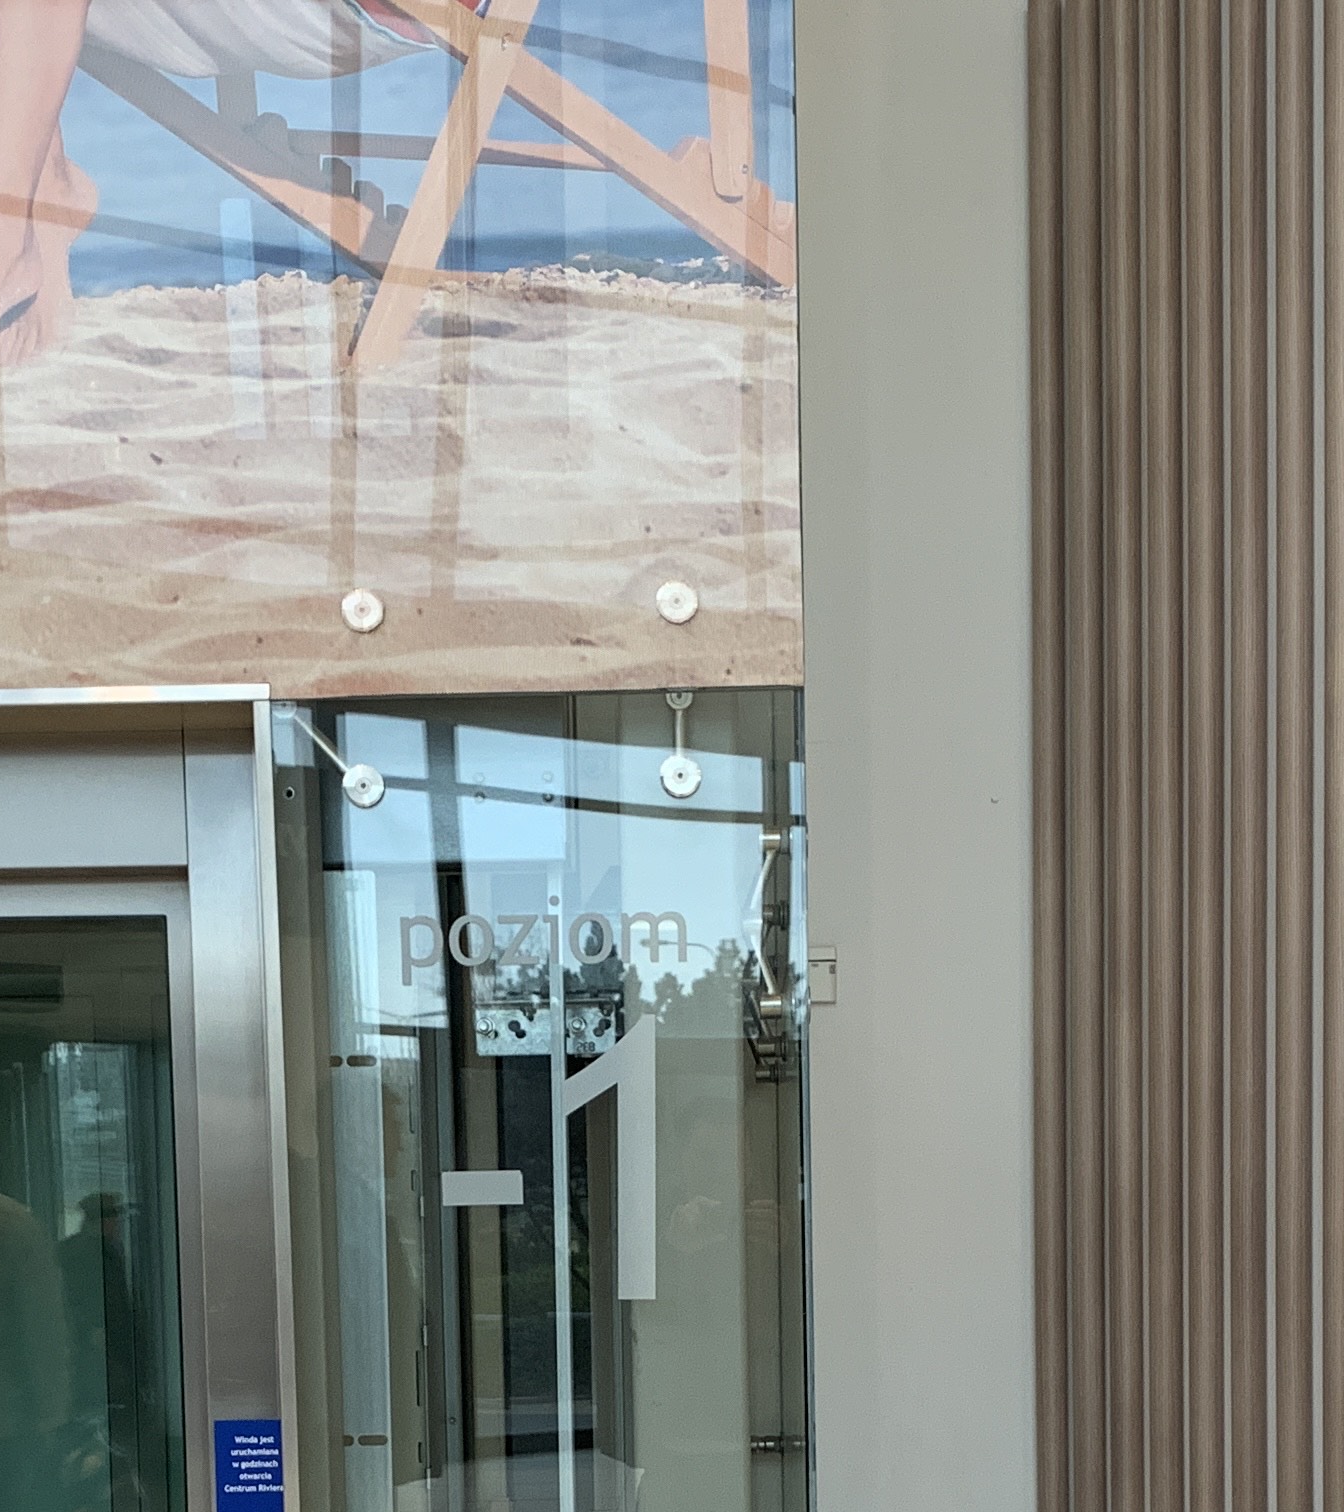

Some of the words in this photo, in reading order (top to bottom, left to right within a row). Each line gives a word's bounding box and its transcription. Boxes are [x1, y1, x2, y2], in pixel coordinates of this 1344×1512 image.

[399, 895, 688, 986] poziom
[234, 1436, 258, 1444] Winda
[259, 1435, 275, 1445] jest
[230, 1448, 279, 1456] uruchamiana
[240, 1459, 279, 1470] godzinach
[239, 1472, 272, 1480] otwarcia
[224, 1484, 257, 1492] Centrum
